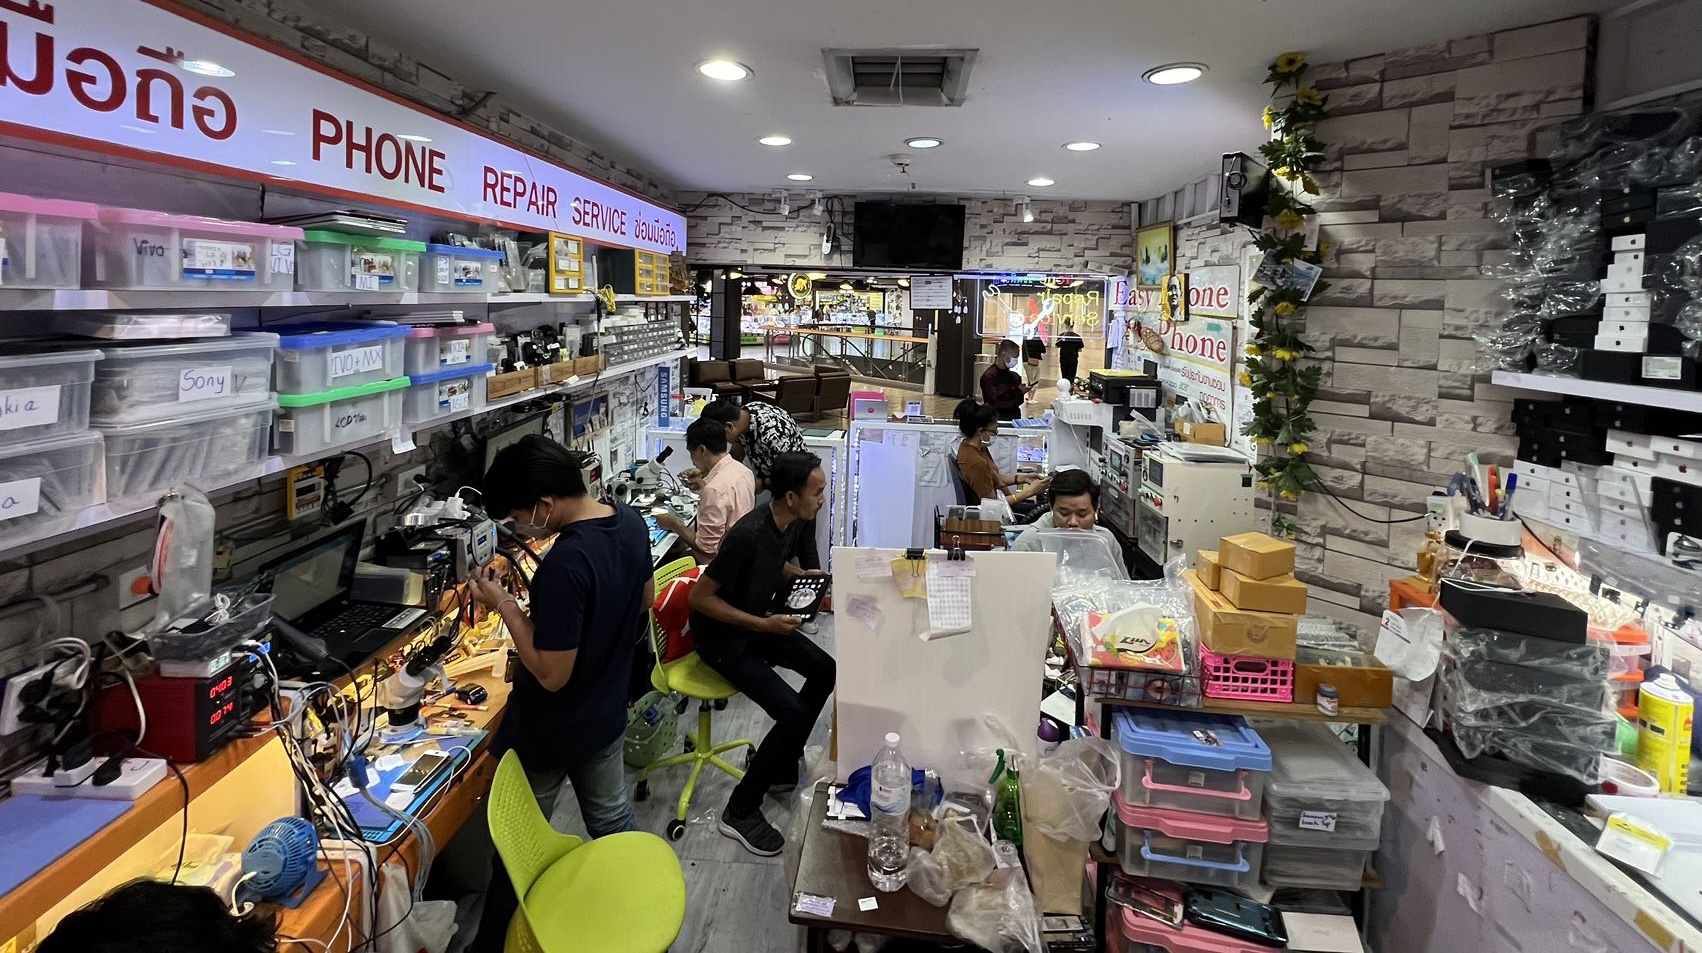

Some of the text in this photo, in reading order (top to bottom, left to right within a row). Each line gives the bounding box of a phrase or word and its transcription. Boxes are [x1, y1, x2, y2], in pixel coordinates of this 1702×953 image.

[312, 108, 446, 193] PHONE
[482, 166, 558, 219] REPAIR
[571, 196, 627, 236] SERVICE
[1113, 280, 1229, 312] Easy one
[181, 370, 225, 394] Sony
[660, 372, 668, 418] SAMSUNG
[0, 396, 40, 417] kia
